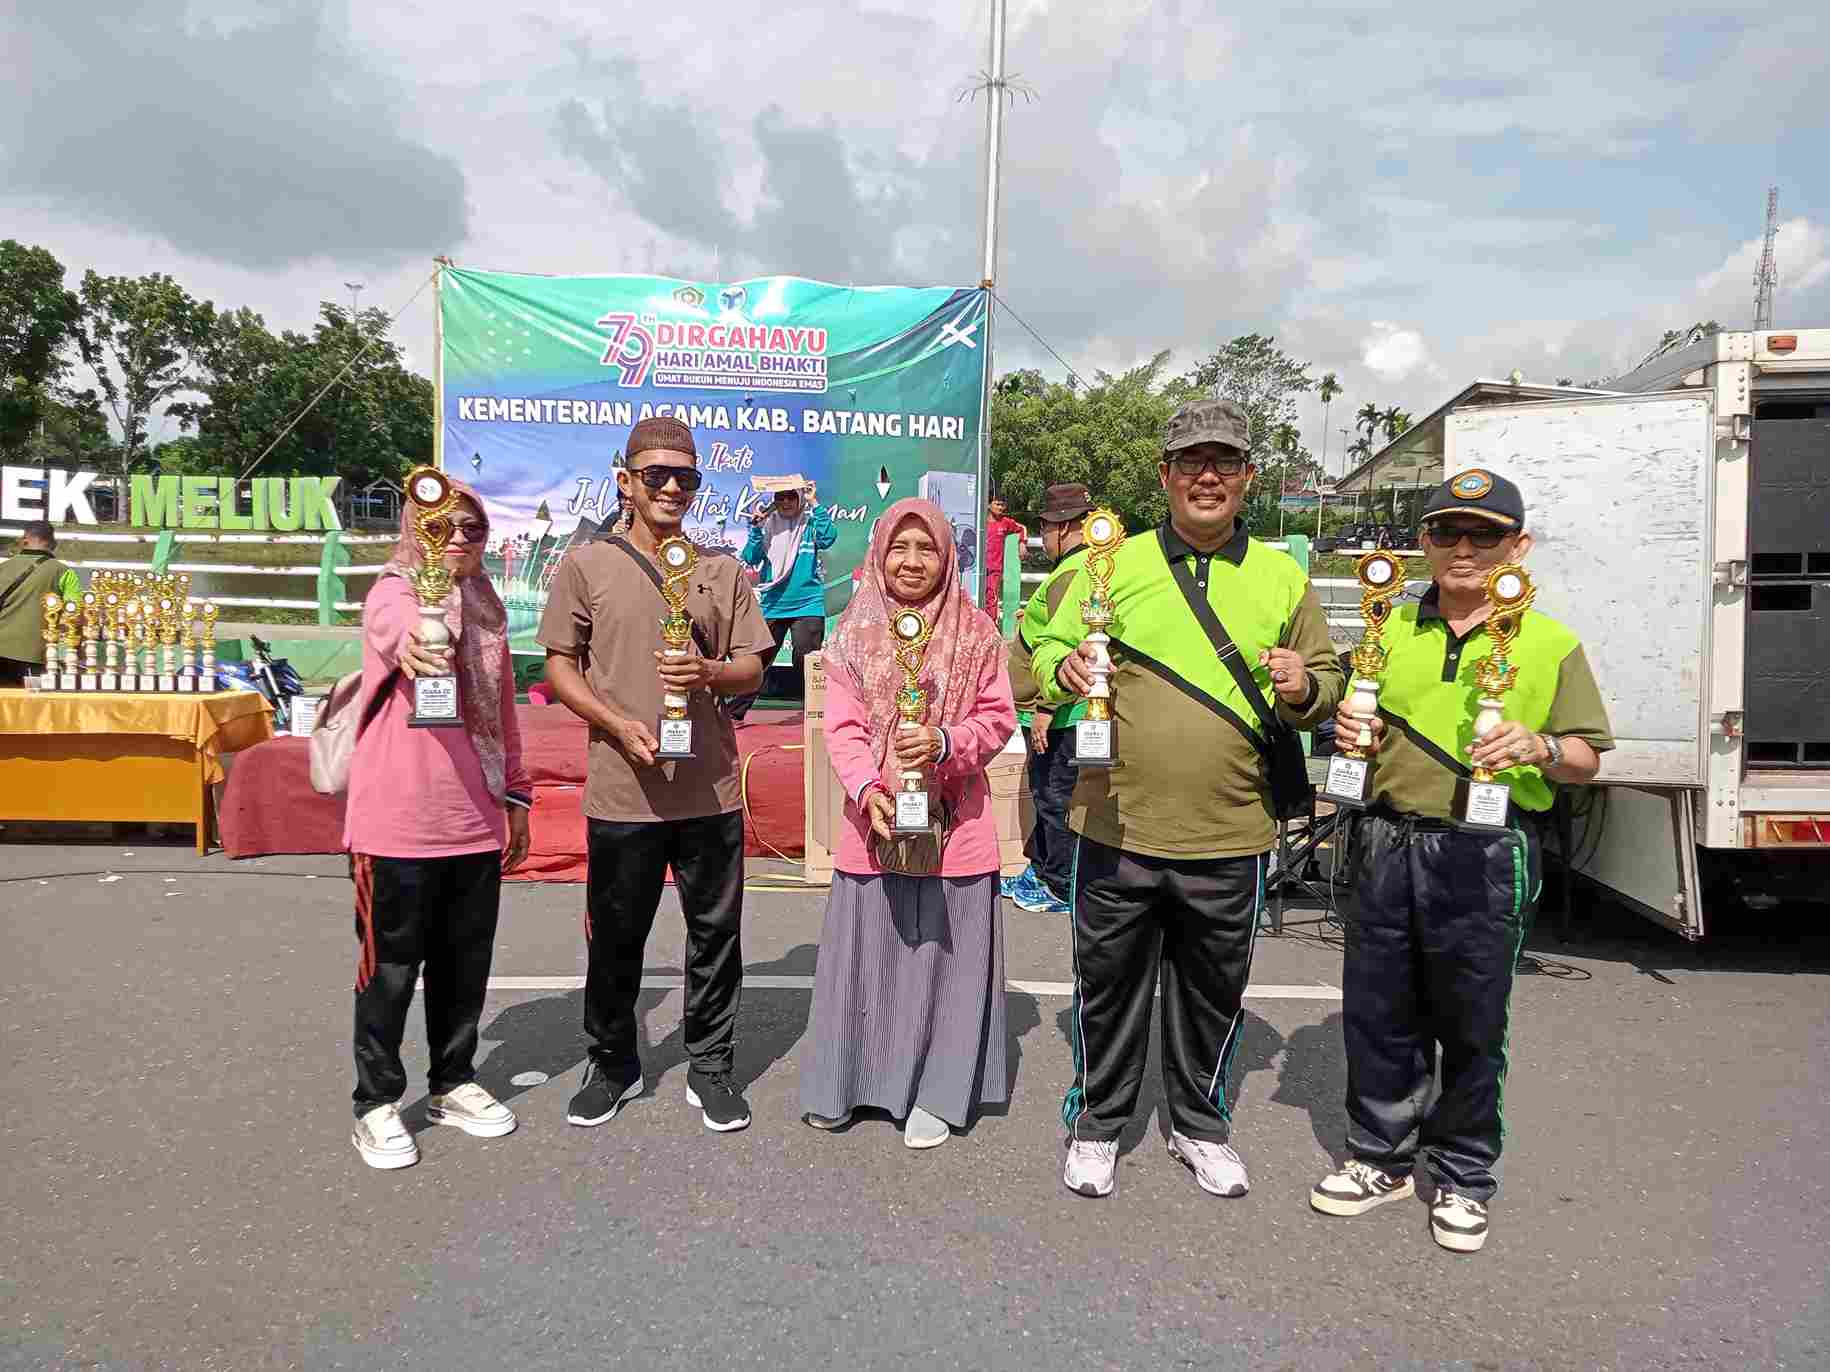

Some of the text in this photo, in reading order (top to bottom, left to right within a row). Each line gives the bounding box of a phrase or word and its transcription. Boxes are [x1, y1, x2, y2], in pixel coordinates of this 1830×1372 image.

[598, 314, 655, 385] 79
[656, 323, 826, 354] DIRGAHAYU
[656, 351, 826, 375] HARI AMAL BHAKTI
[656, 373, 824, 390] UMAT RUKUN MENUJU INDONESIA EMAS
[458, 397, 632, 426] KEMENTERIAN
[736, 406, 796, 432] KAB.
[803, 409, 902, 437] BATANG
[908, 414, 964, 440] HARI
[129, 475, 345, 531] MELIUK
[568, 477, 621, 521] Jal
